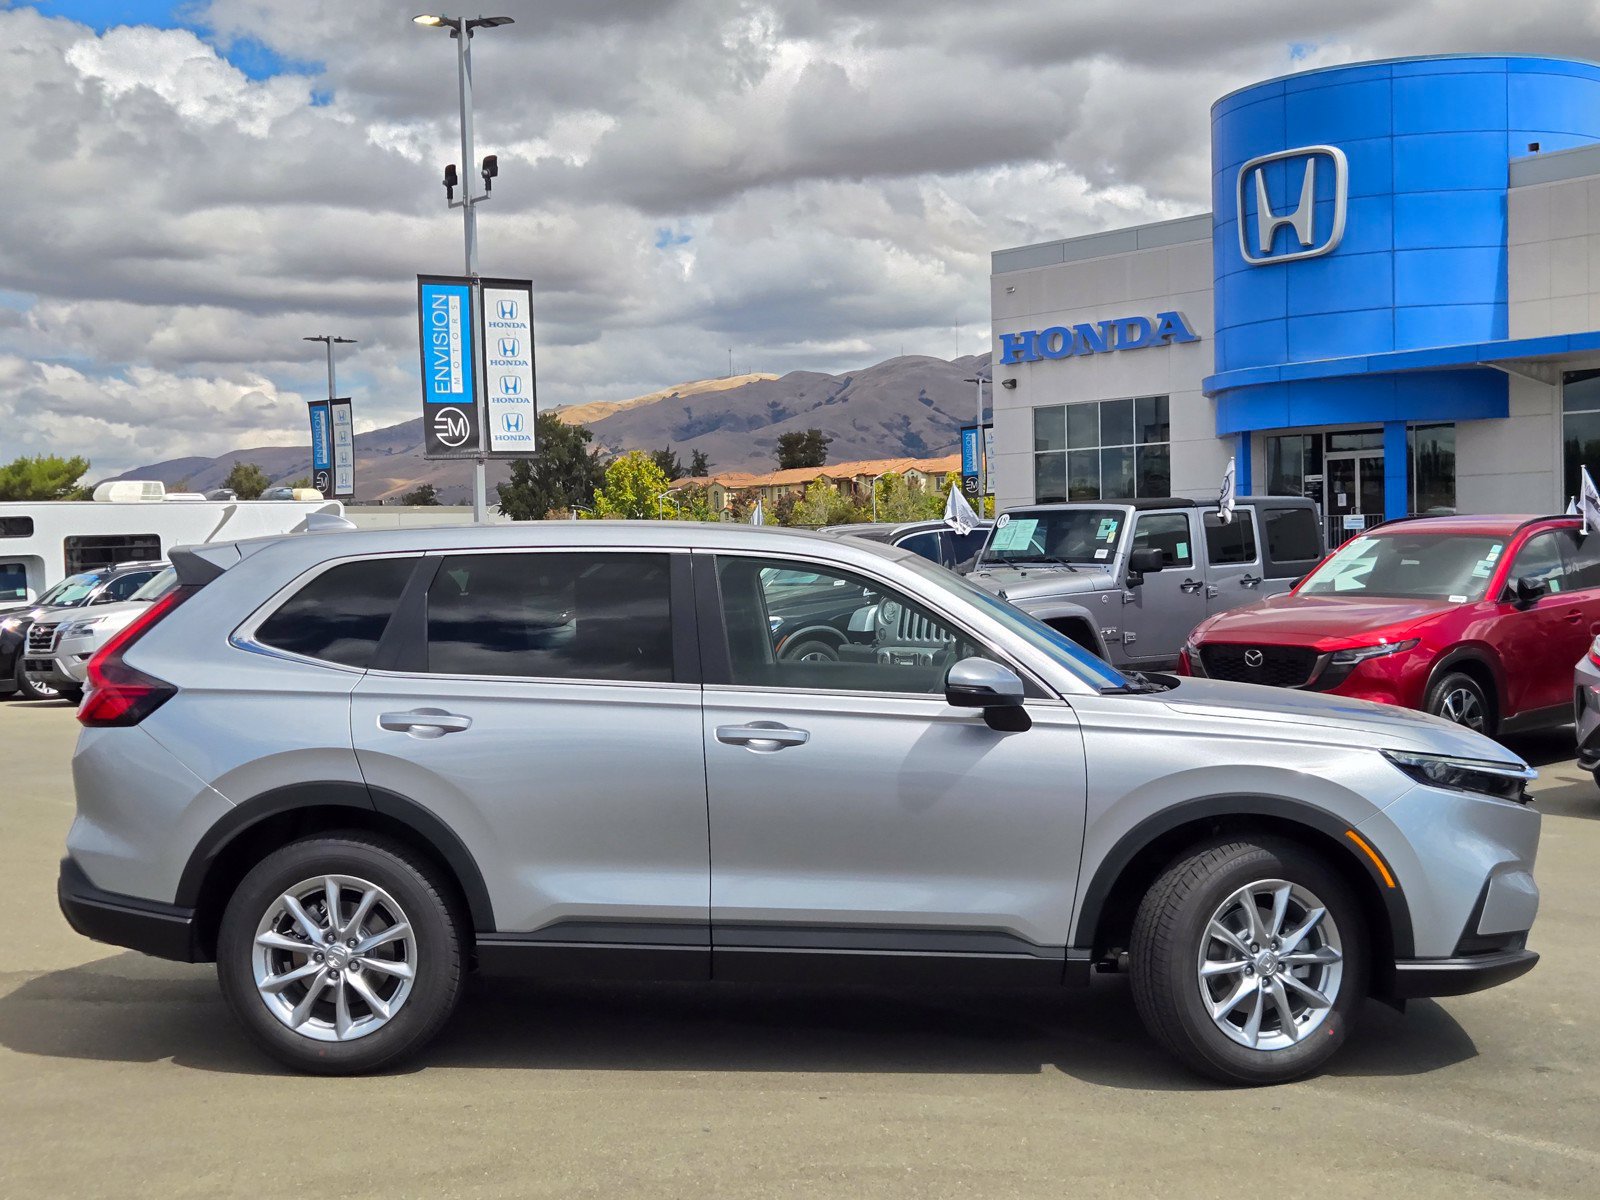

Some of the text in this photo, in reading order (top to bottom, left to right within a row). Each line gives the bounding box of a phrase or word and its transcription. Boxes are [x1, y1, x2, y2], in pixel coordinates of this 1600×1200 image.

[488, 321, 528, 330] HONDA
[431, 293, 451, 394] ENVISION
[452, 304, 460, 385] MOTORS
[999, 311, 1200, 365] HONDA
[489, 359, 529, 367] HONDA
[492, 397, 530, 405] HONDA
[494, 434, 531, 442] HONDA
[965, 433, 973, 472] ENVISION
